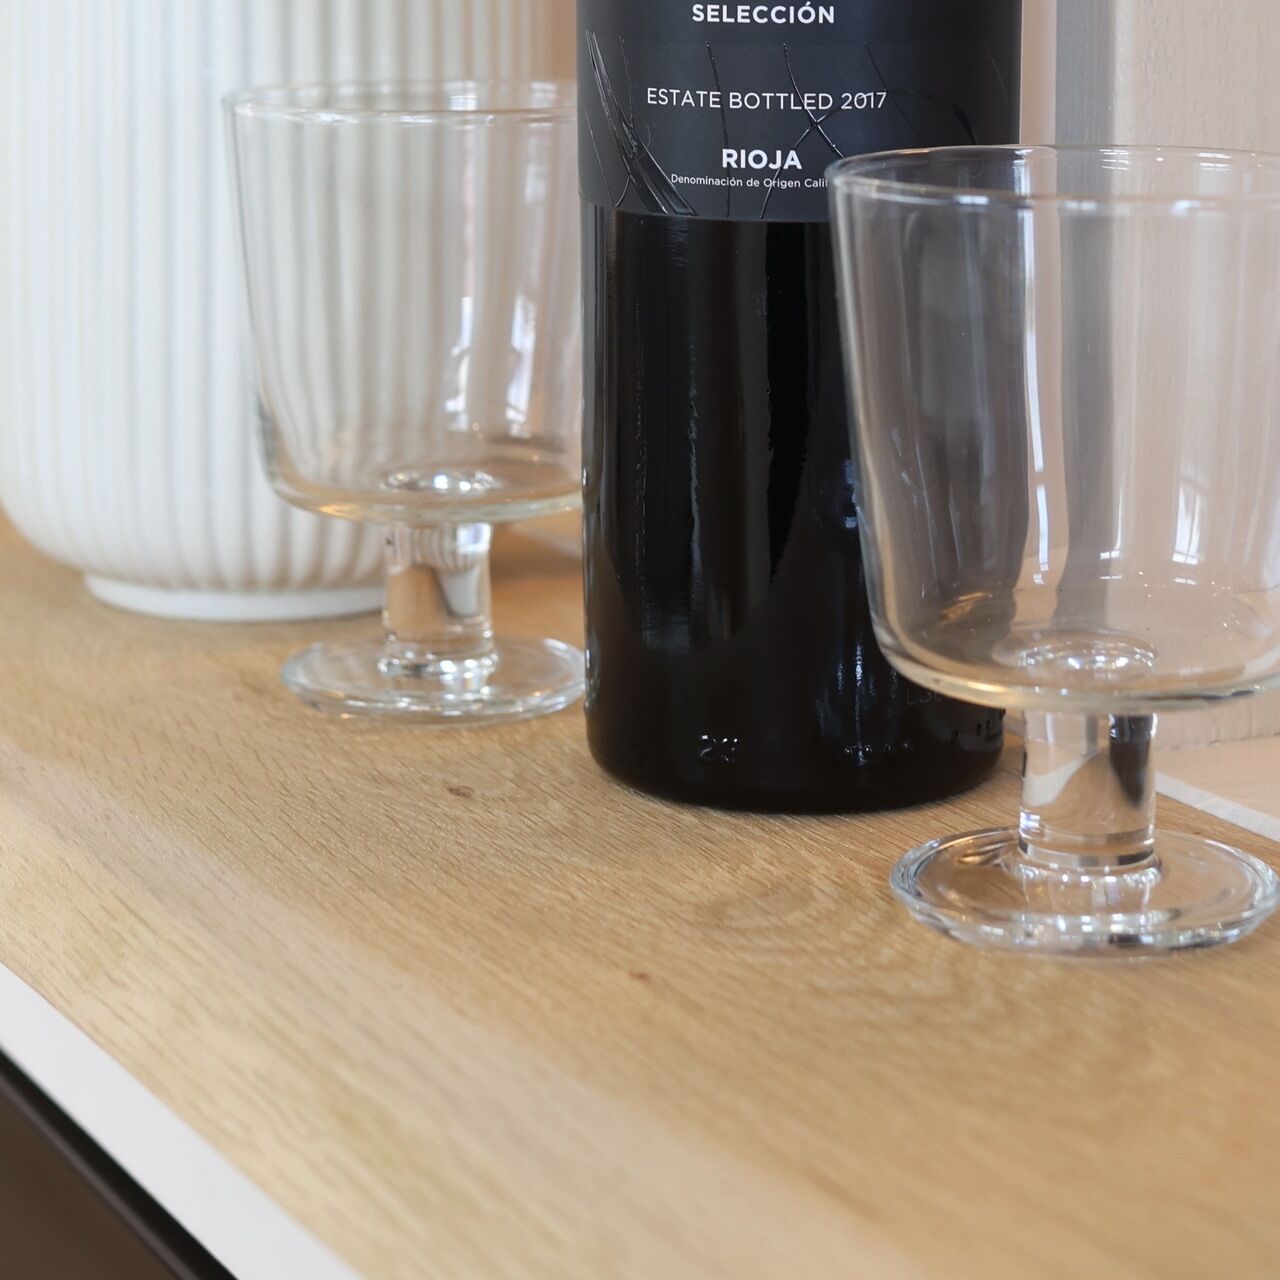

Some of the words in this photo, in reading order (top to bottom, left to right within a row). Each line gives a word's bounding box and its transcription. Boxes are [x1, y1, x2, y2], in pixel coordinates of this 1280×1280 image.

[691, 1, 835, 24] SELECCIÓN
[647, 87, 722, 108] ESTATE
[729, 91, 833, 110] BOTTLED
[841, 92, 887, 110] 2017
[722, 148, 802, 170] RIOJA
[671, 174, 743, 187] Denominación
[746, 177, 760, 187] de
[763, 177, 801, 189] Origen
